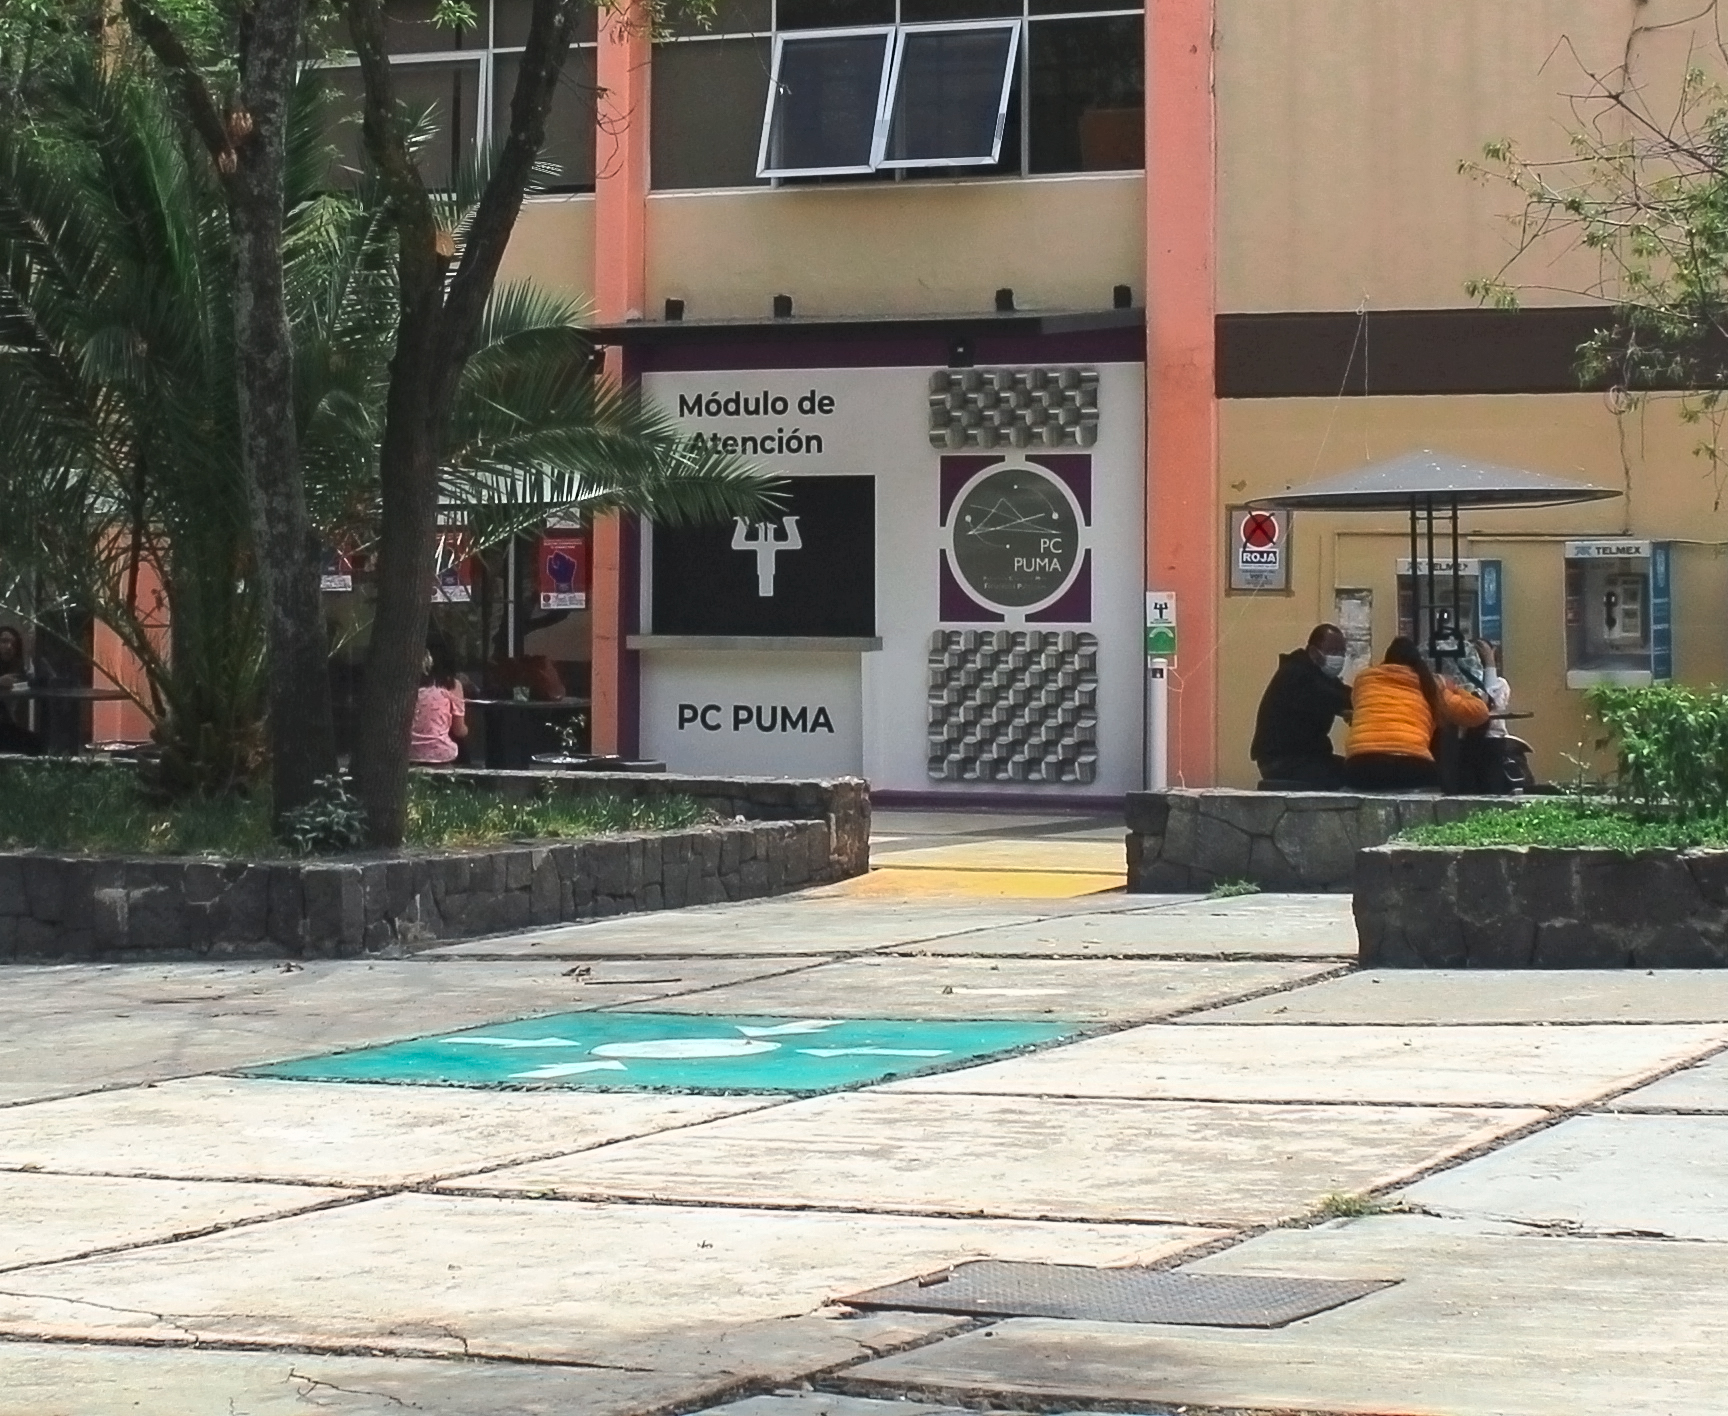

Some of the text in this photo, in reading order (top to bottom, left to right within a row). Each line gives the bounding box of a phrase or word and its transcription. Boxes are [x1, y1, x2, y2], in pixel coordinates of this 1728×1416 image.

[678, 389, 835, 418] Módulo de
[689, 427, 823, 455] Atención
[1040, 538, 1063, 554] PC
[1595, 546, 1641, 555] TELMEX
[1014, 557, 1062, 572] PUMA
[1243, 552, 1275, 562] ROJA
[678, 703, 835, 734] PC PUMA
